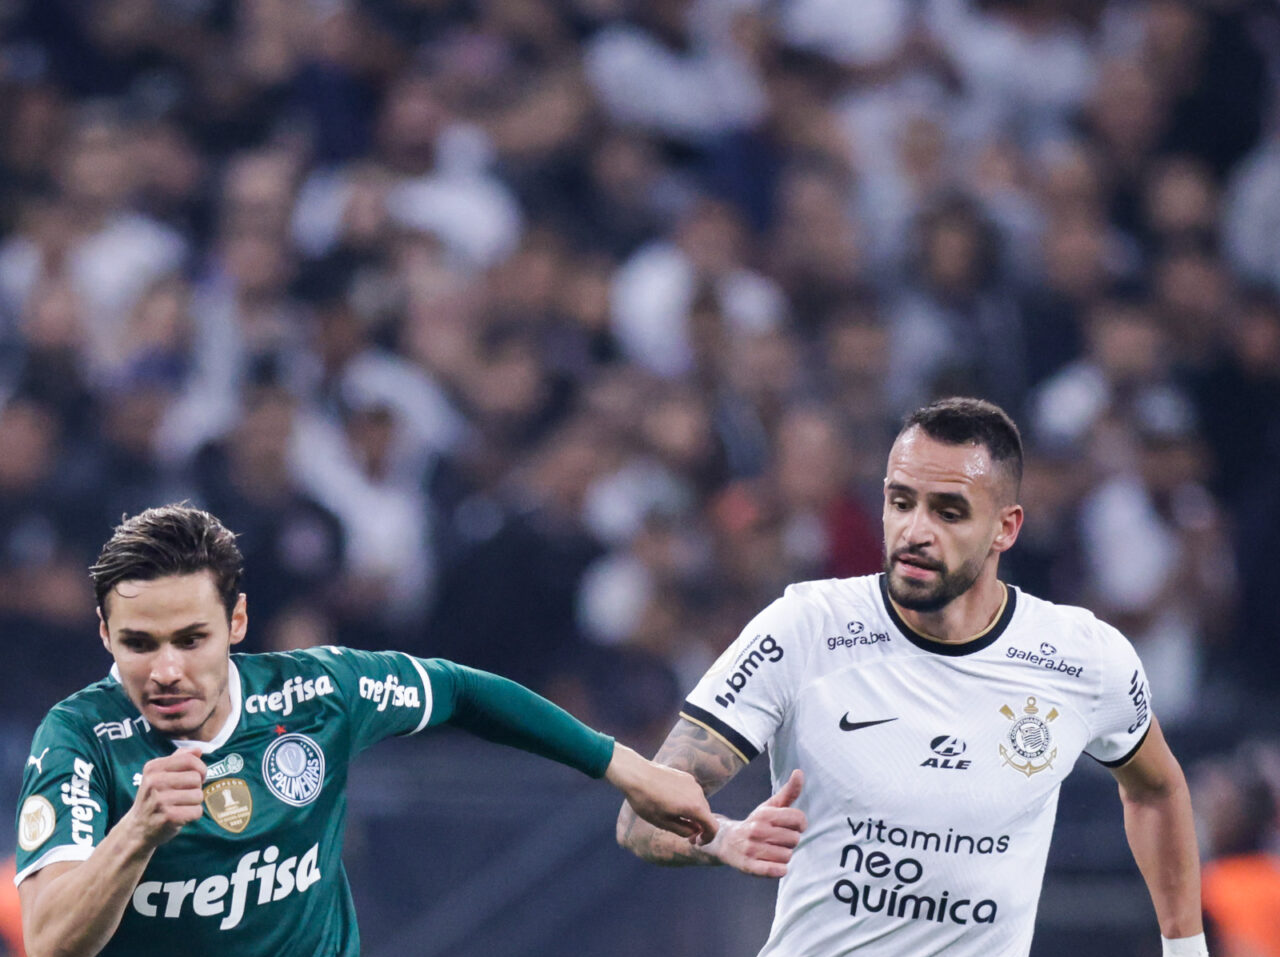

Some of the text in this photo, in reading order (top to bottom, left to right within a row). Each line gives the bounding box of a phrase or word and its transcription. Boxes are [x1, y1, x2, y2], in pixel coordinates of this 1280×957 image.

[826, 631, 891, 651] gaera.bet
[726, 634, 784, 693] bmg
[1005, 645, 1084, 679] galera.bet
[245, 674, 334, 717] crefisa
[358, 674, 421, 712] crefisa
[271, 758, 320, 800] PALMEIRAS
[920, 757, 972, 770] ALE
[61, 757, 101, 847] crefisa
[847, 816, 1010, 855] vitaminas
[840, 844, 923, 884] neo
[132, 841, 322, 931] crefisa
[833, 878, 998, 925] química
